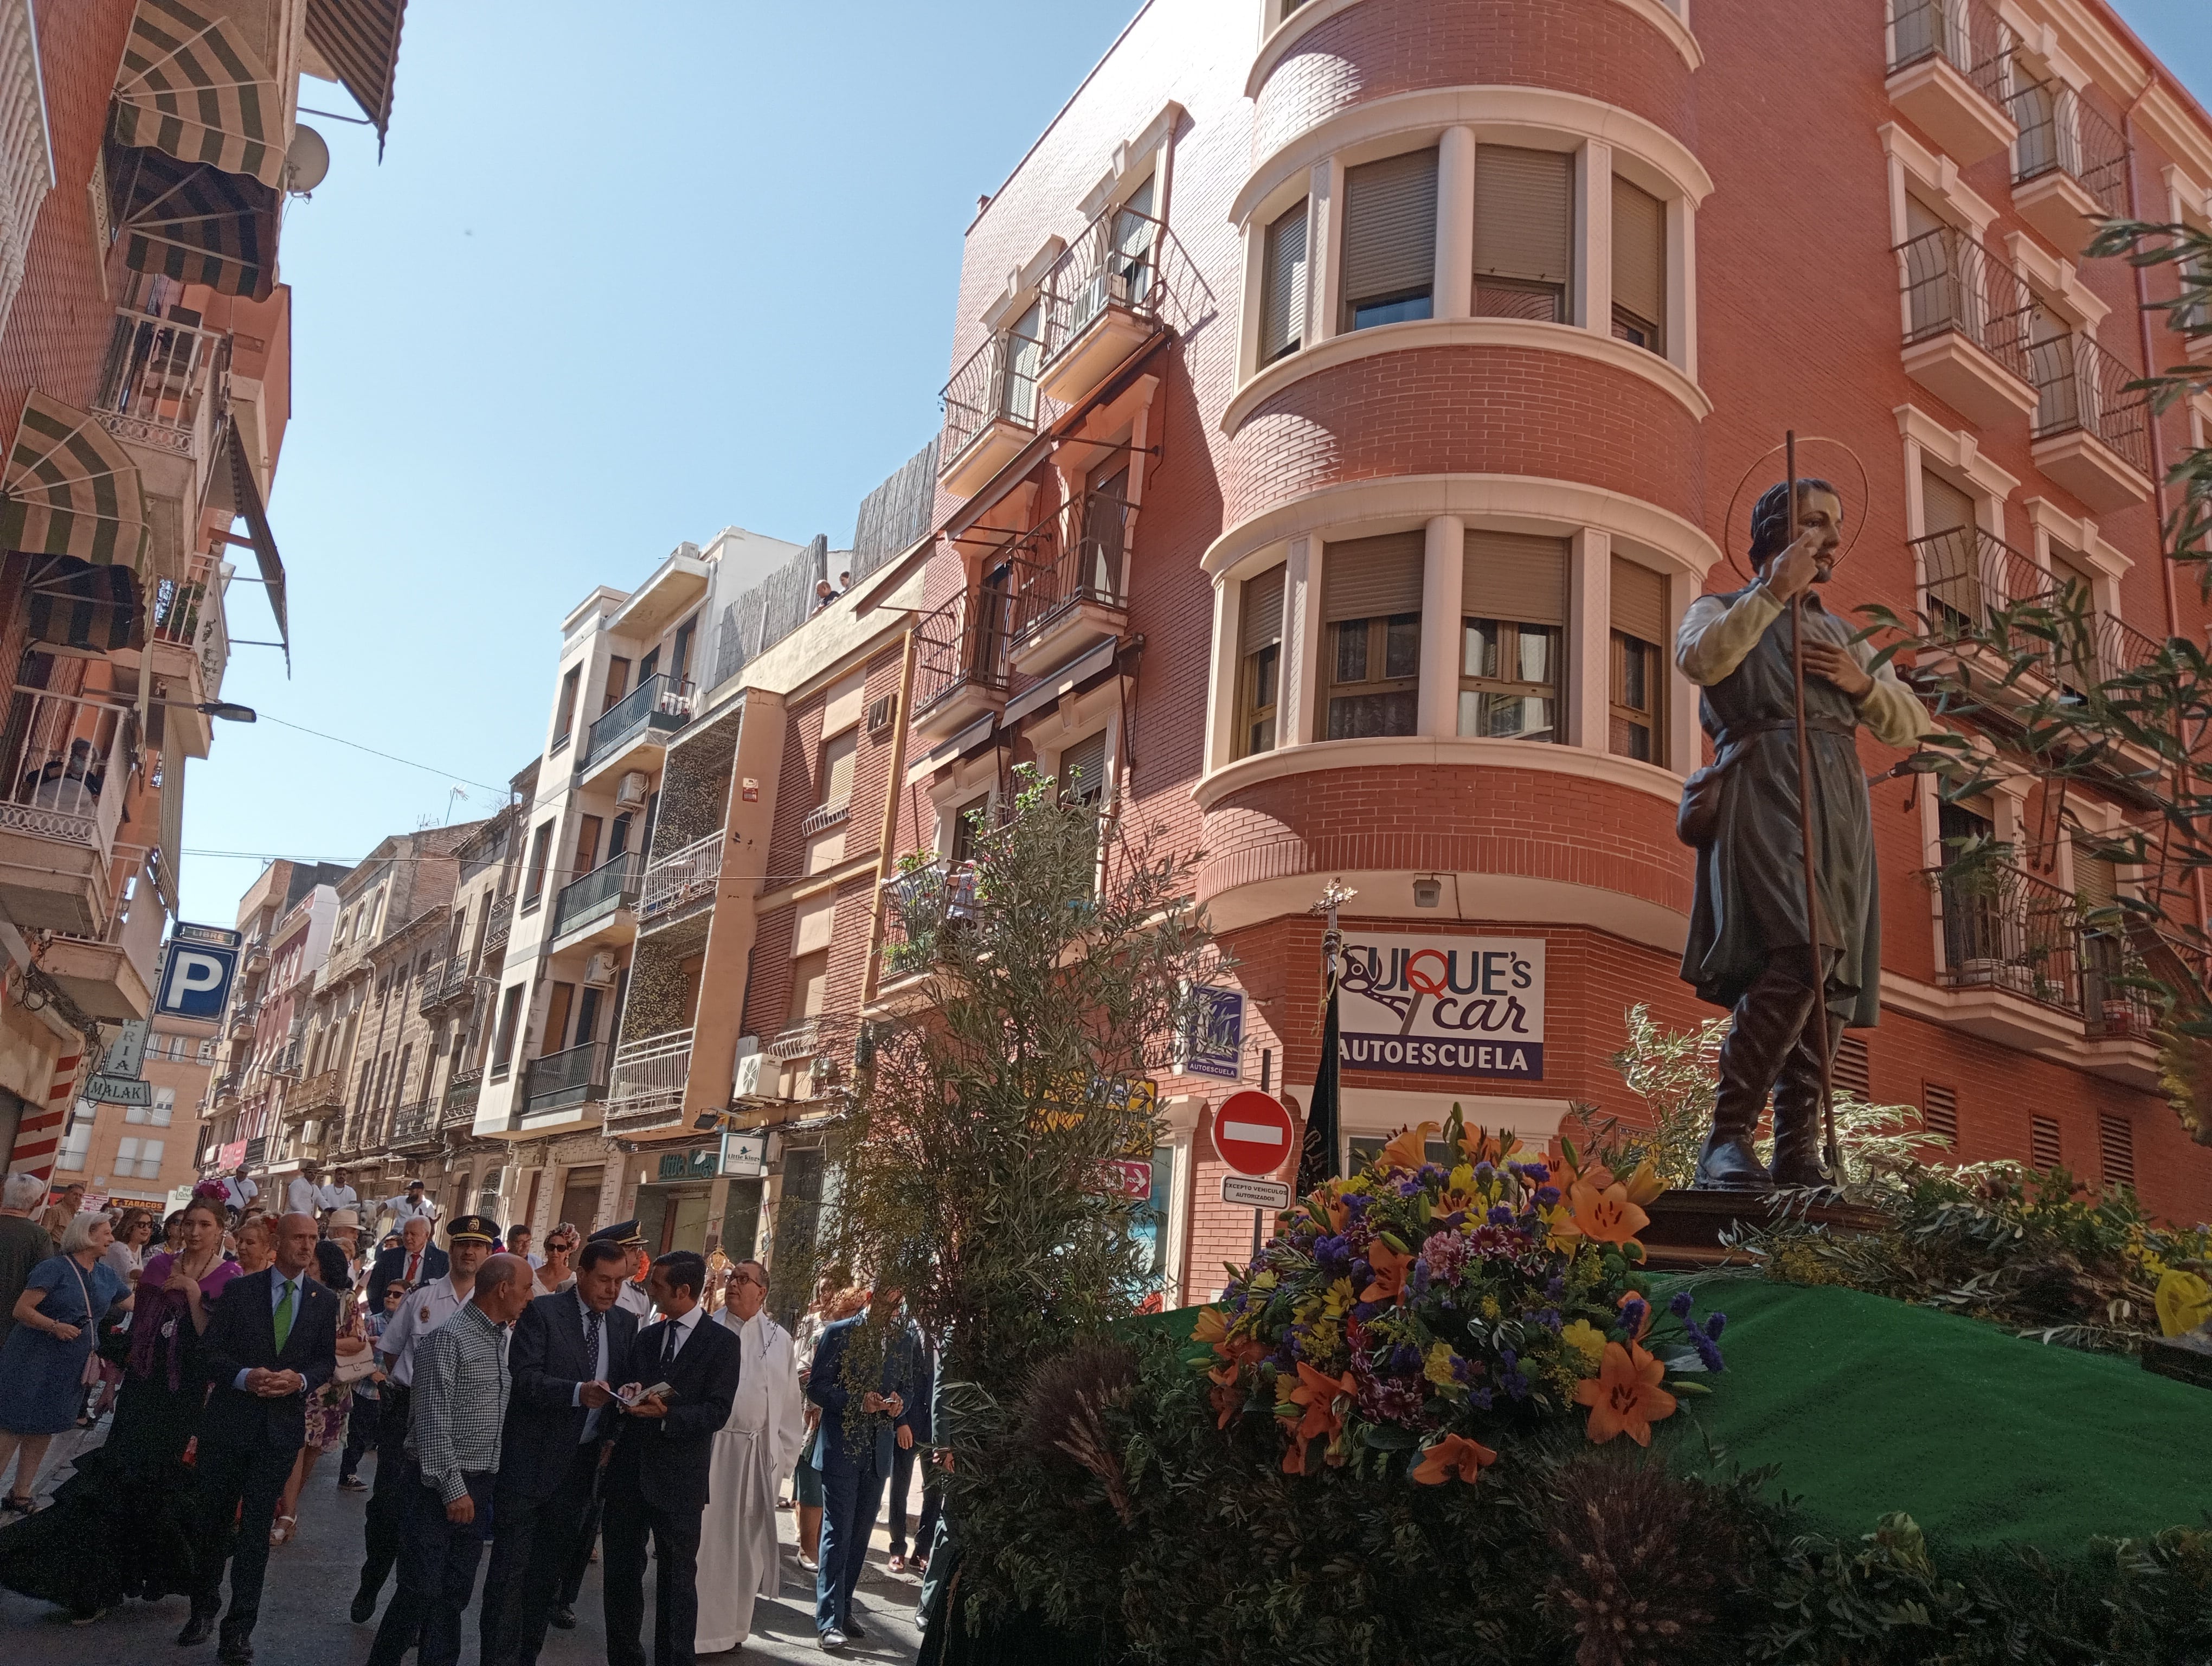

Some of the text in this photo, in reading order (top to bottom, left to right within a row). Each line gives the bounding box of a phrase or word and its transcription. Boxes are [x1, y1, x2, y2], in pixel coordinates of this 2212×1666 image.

[192, 929, 224, 940] LIBRE
[166, 951, 223, 1009] P
[1432, 996, 1529, 1034] car
[1189, 1063, 1234, 1077] AUTOESCUELA
[90, 1082, 142, 1099] MALAK
[1225, 1183, 1288, 1196] EXCEPTO VEHICULOS
[1236, 1192, 1275, 1202] AUTORIZADOS
[124, 1200, 163, 1209] TABACOS
